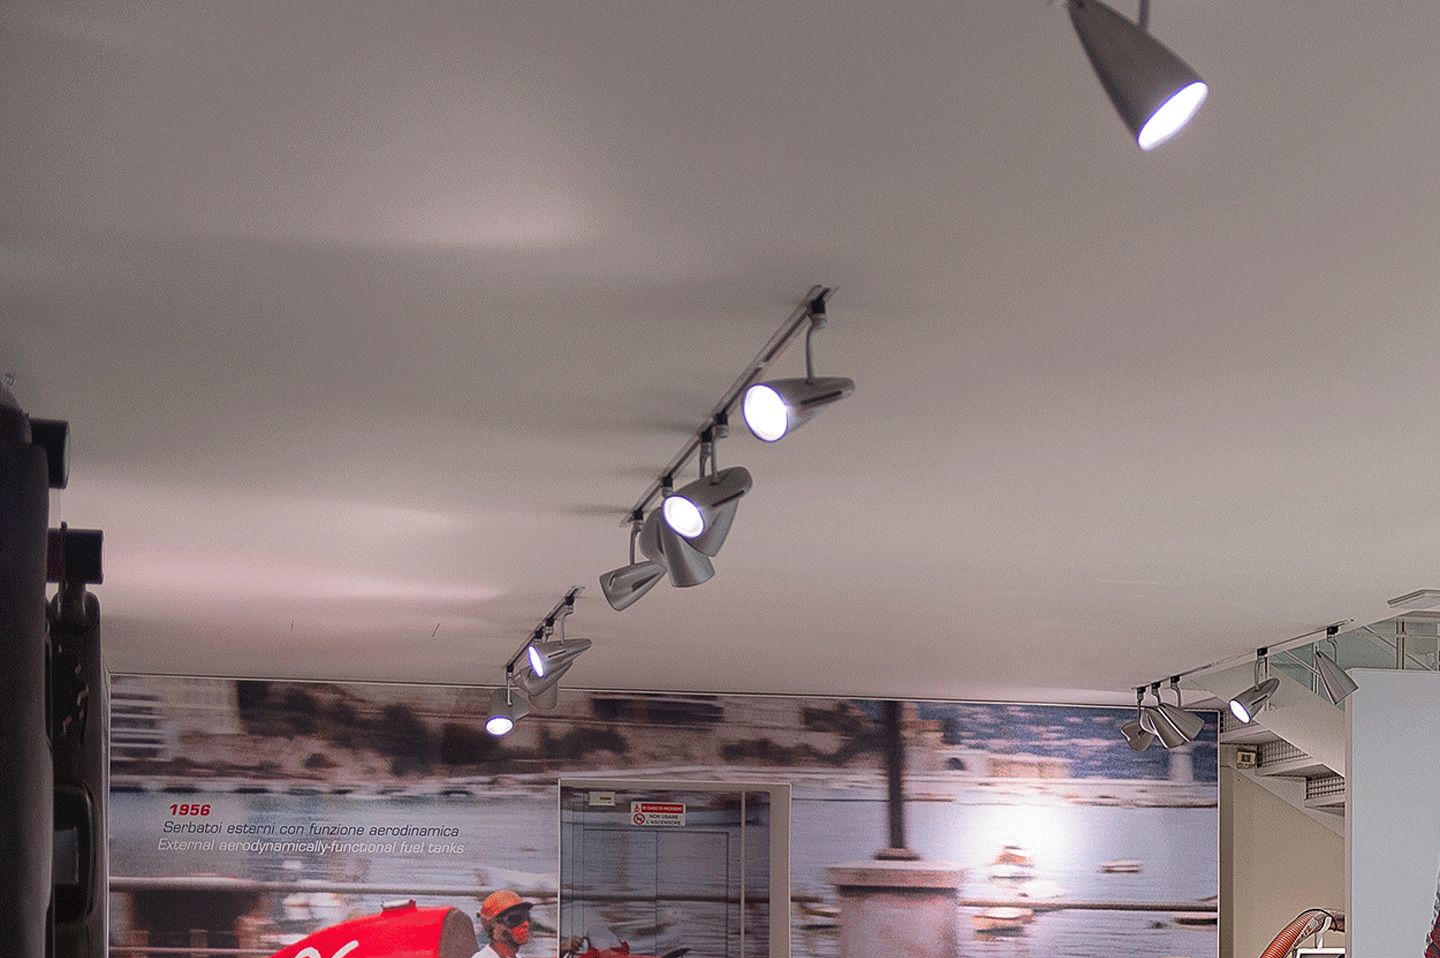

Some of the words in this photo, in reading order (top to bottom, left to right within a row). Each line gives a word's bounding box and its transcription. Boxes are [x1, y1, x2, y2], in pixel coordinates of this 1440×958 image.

[169, 803, 211, 816] 1956
[163, 821, 223, 834] Serbatoi
[226, 822, 276, 835] esterni
[279, 825, 305, 835] con
[309, 823, 365, 836] funzione
[369, 824, 460, 837] aerodinamica
[158, 838, 216, 851] External
[219, 840, 396, 855] aerodynamically-functional
[400, 841, 425, 853] fuel
[427, 842, 465, 854] tanks
